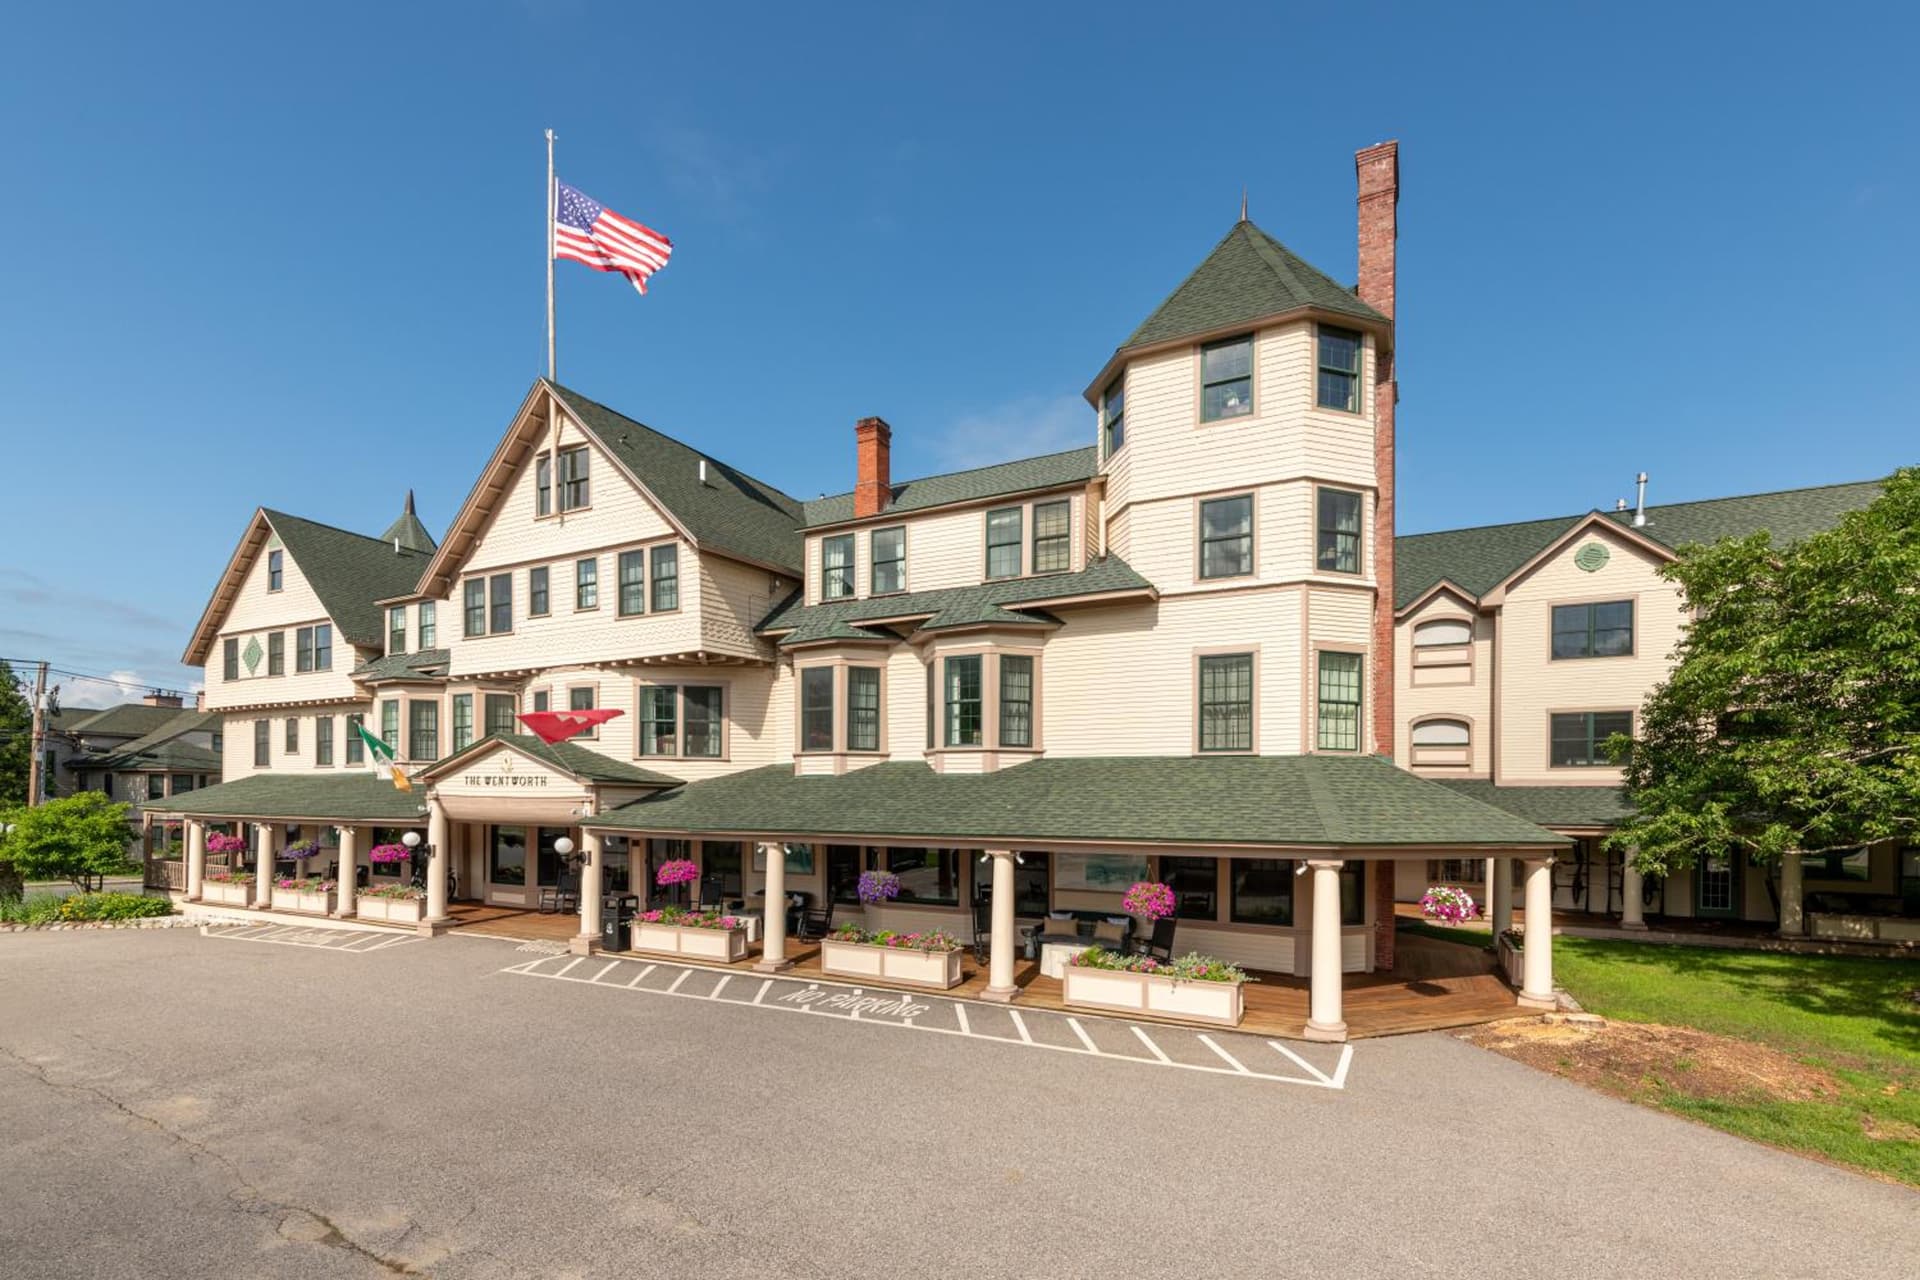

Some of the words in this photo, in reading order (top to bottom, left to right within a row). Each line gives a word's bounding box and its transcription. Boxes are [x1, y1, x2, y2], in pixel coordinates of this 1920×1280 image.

[465, 776, 481, 785] THE
[484, 776, 547, 787] WENTWORTH
[779, 989, 825, 1002] NO
[817, 993, 930, 1017] PARKING
